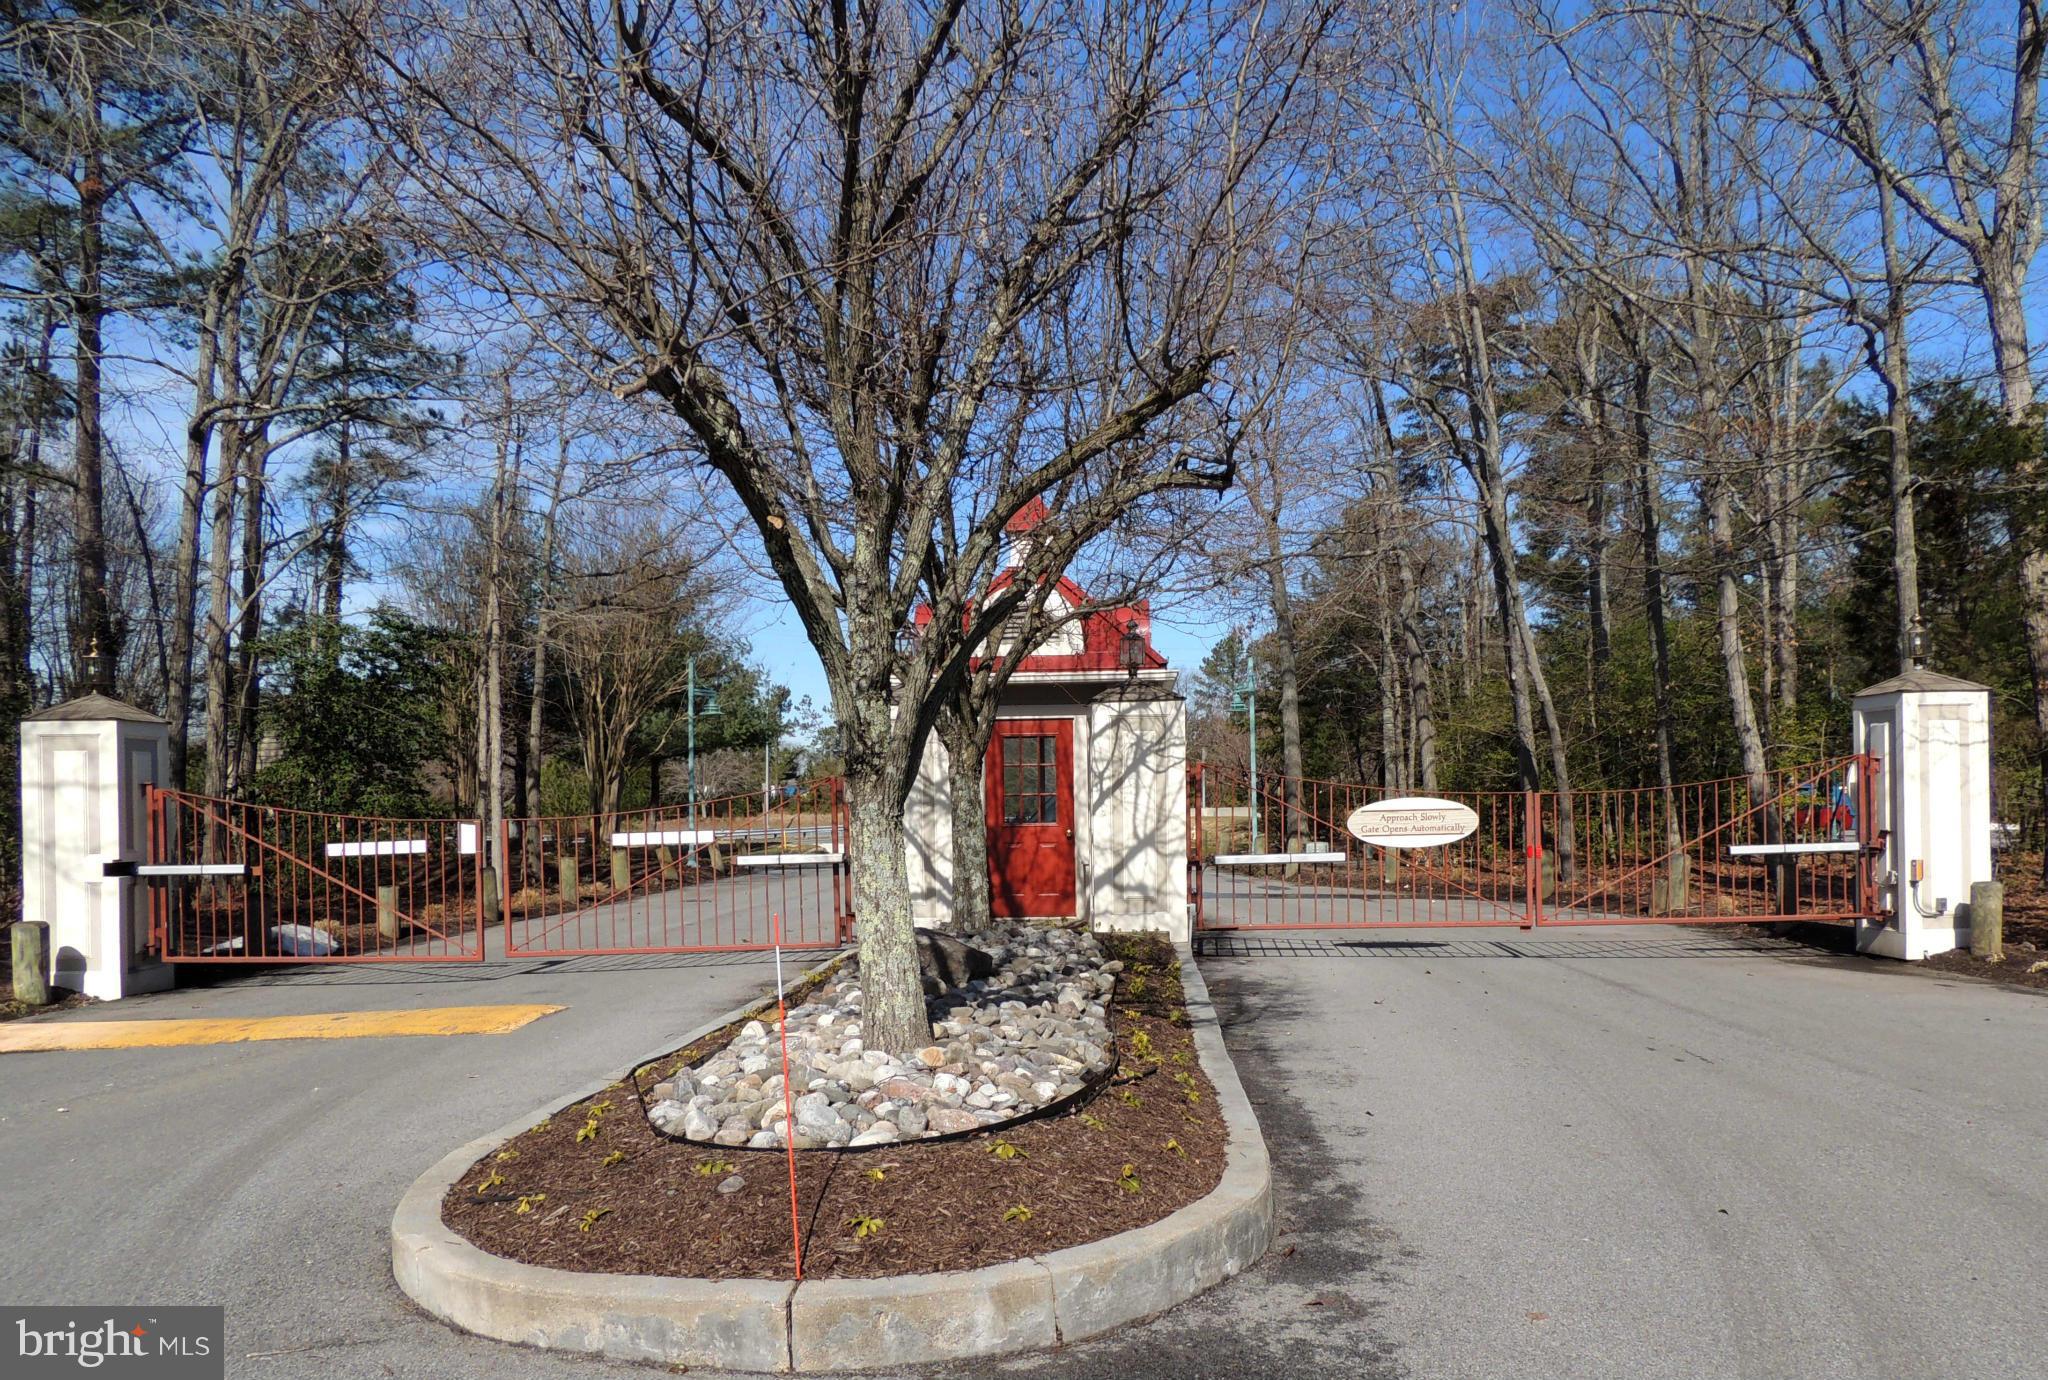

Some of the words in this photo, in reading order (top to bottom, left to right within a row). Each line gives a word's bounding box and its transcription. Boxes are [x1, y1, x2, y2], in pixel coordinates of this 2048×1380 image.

[1380, 813, 1418, 823] Approach
[1420, 812, 1446, 822] Slowly
[1361, 825, 1380, 833] Gate
[1382, 825, 1408, 834] Opens
[1410, 824, 1465, 833] Automatically
